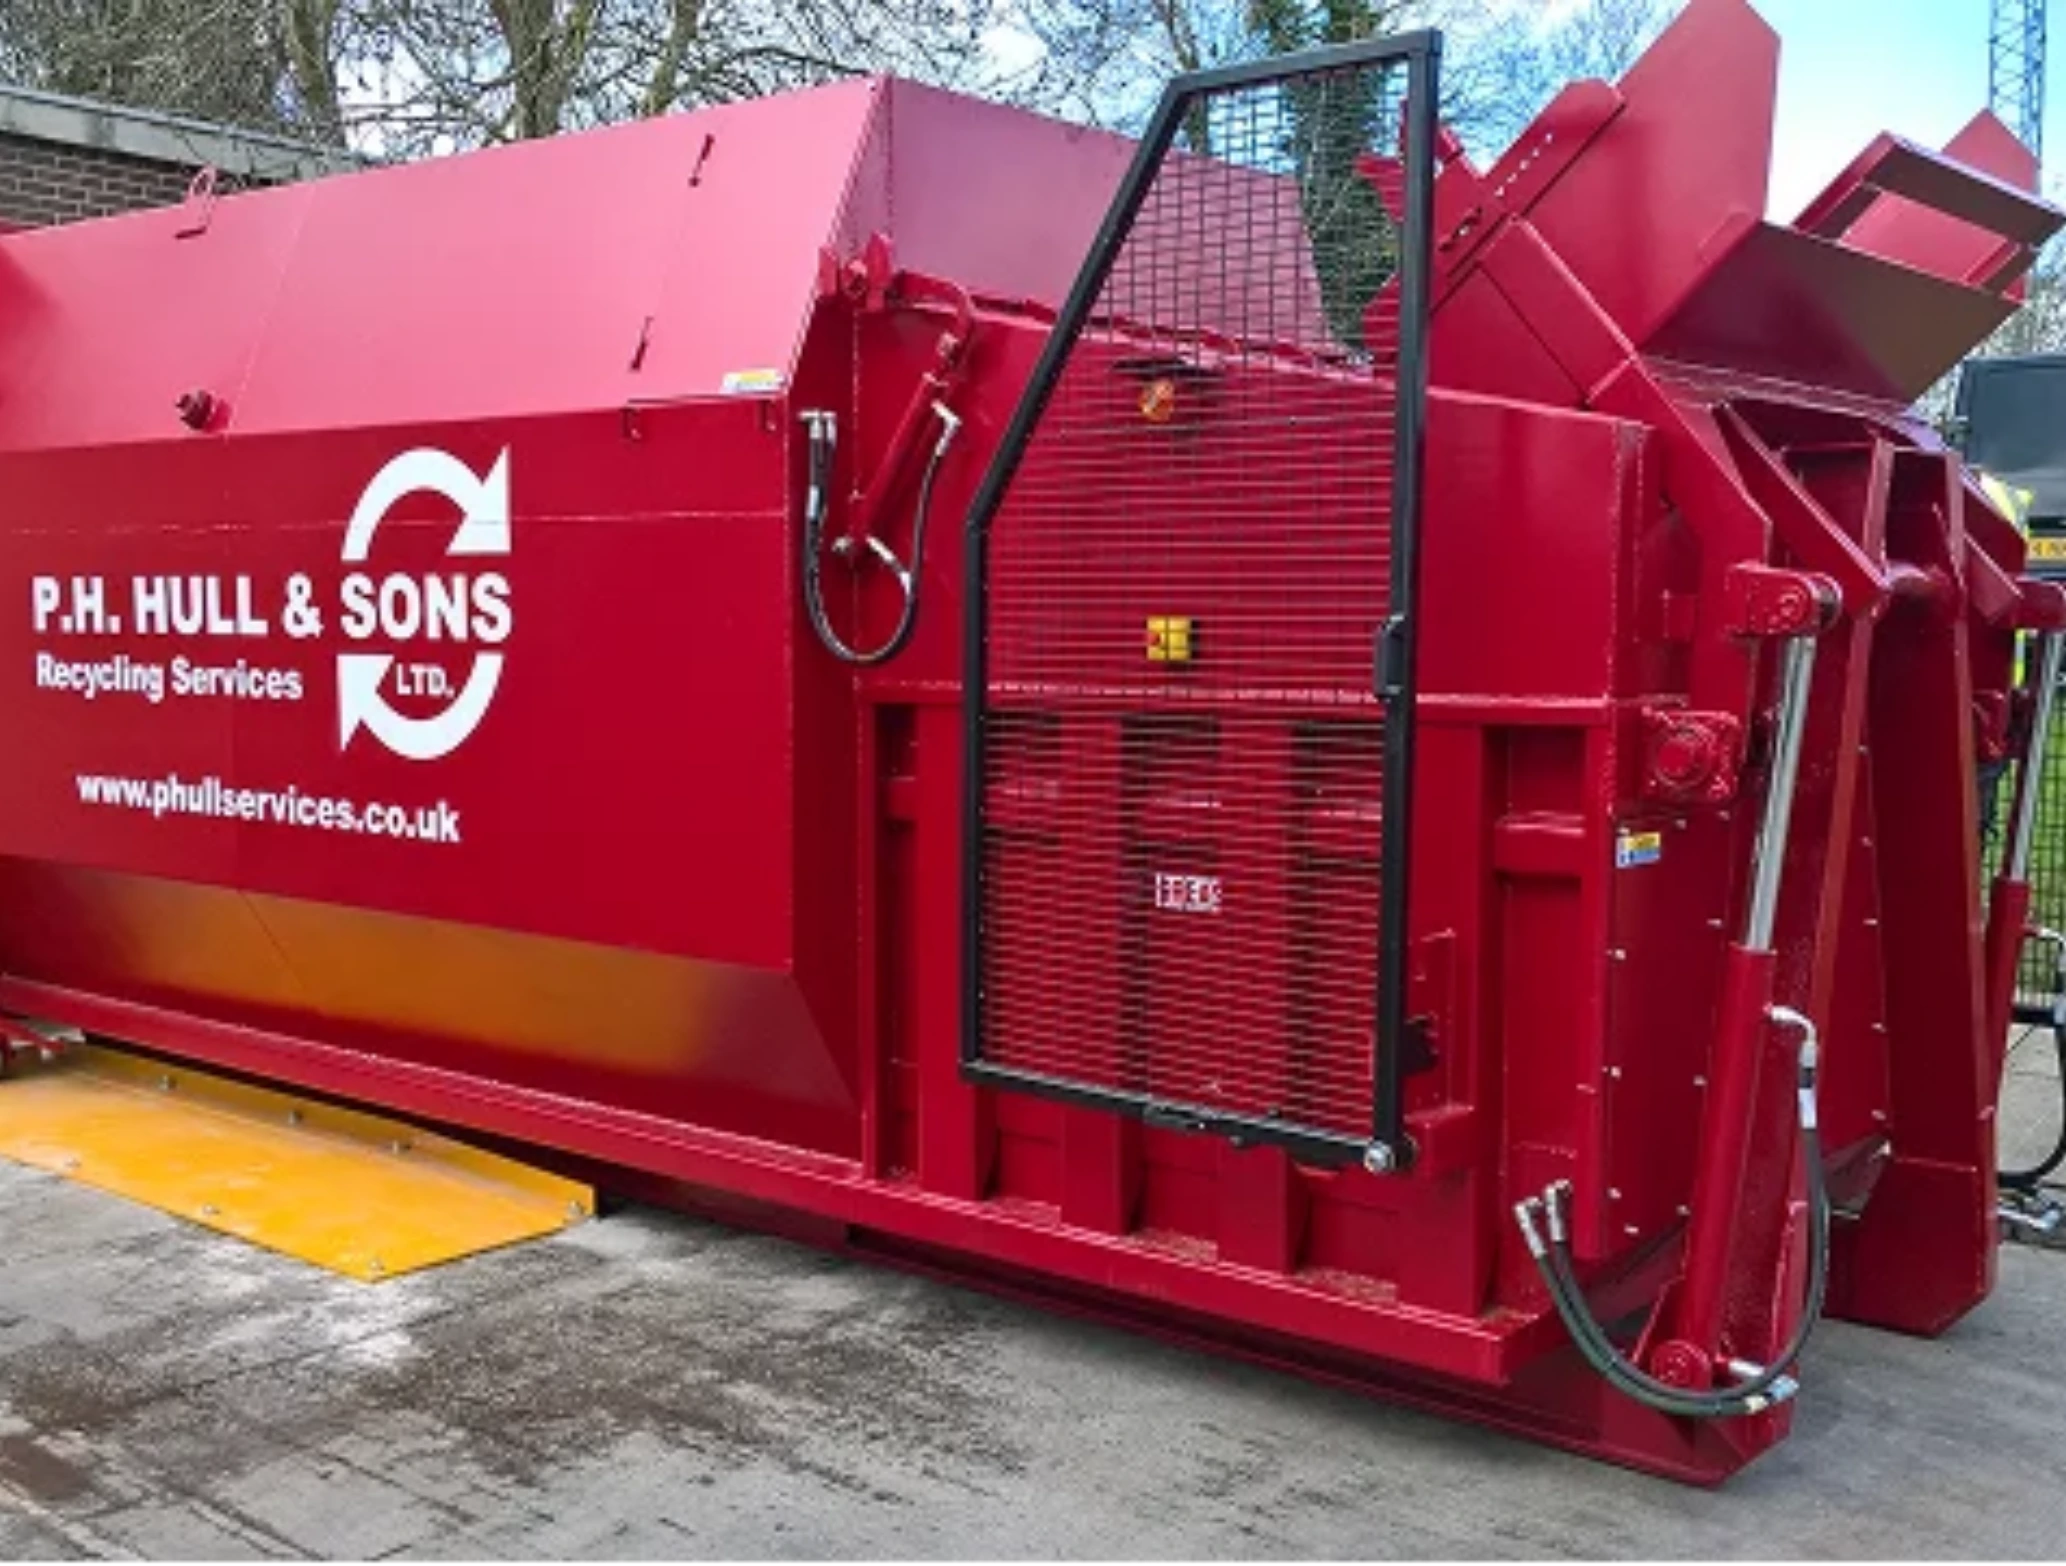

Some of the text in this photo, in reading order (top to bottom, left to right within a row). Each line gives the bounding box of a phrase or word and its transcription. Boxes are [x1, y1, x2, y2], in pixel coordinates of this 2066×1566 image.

[32, 572, 512, 643] P.H. HULL & SONS
[36, 652, 303, 704] Recycling Services
[396, 663, 454, 699] LTD.
[76, 773, 460, 843] www.phullservices.co.uk
